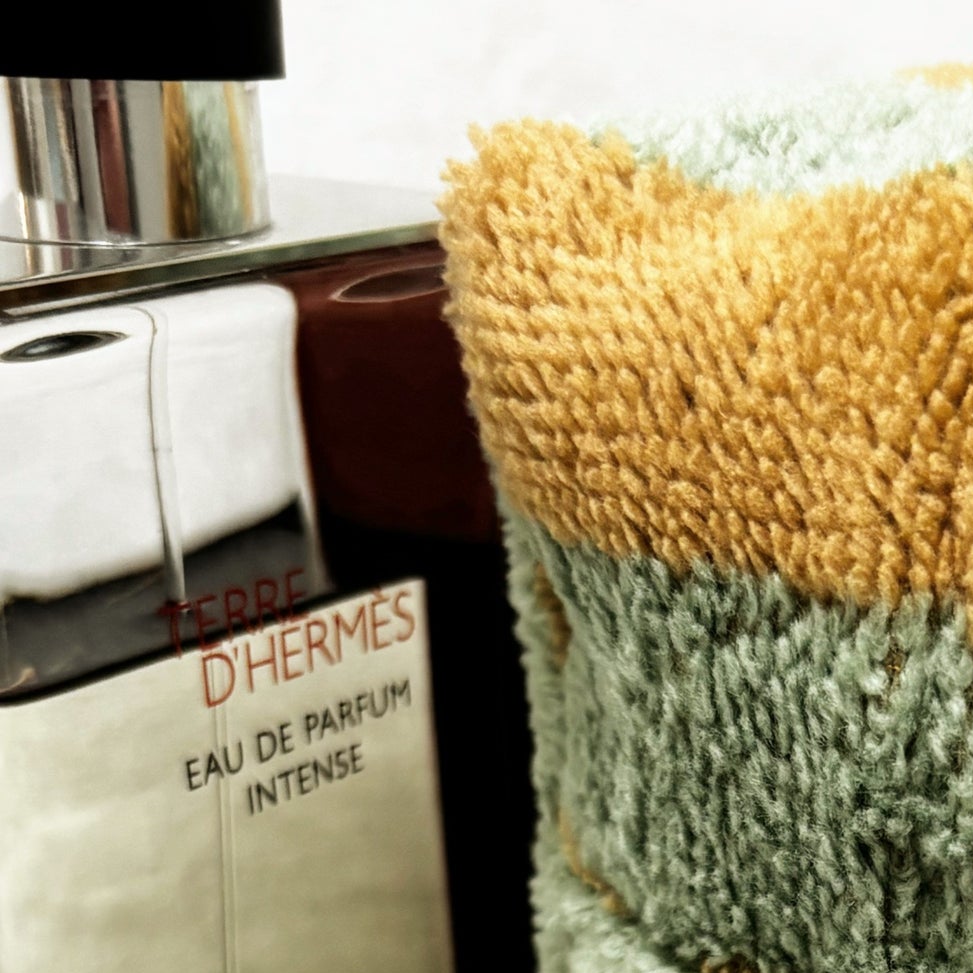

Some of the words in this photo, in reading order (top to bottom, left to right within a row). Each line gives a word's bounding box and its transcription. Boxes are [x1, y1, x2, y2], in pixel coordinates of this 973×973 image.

[157, 567, 309, 659] TERRE
[201, 587, 416, 709] D'HERMÈS
[185, 741, 244, 792] EAU
[256, 721, 295, 764] DE
[303, 679, 413, 744] PARFUM
[246, 743, 366, 816] INTENSE
